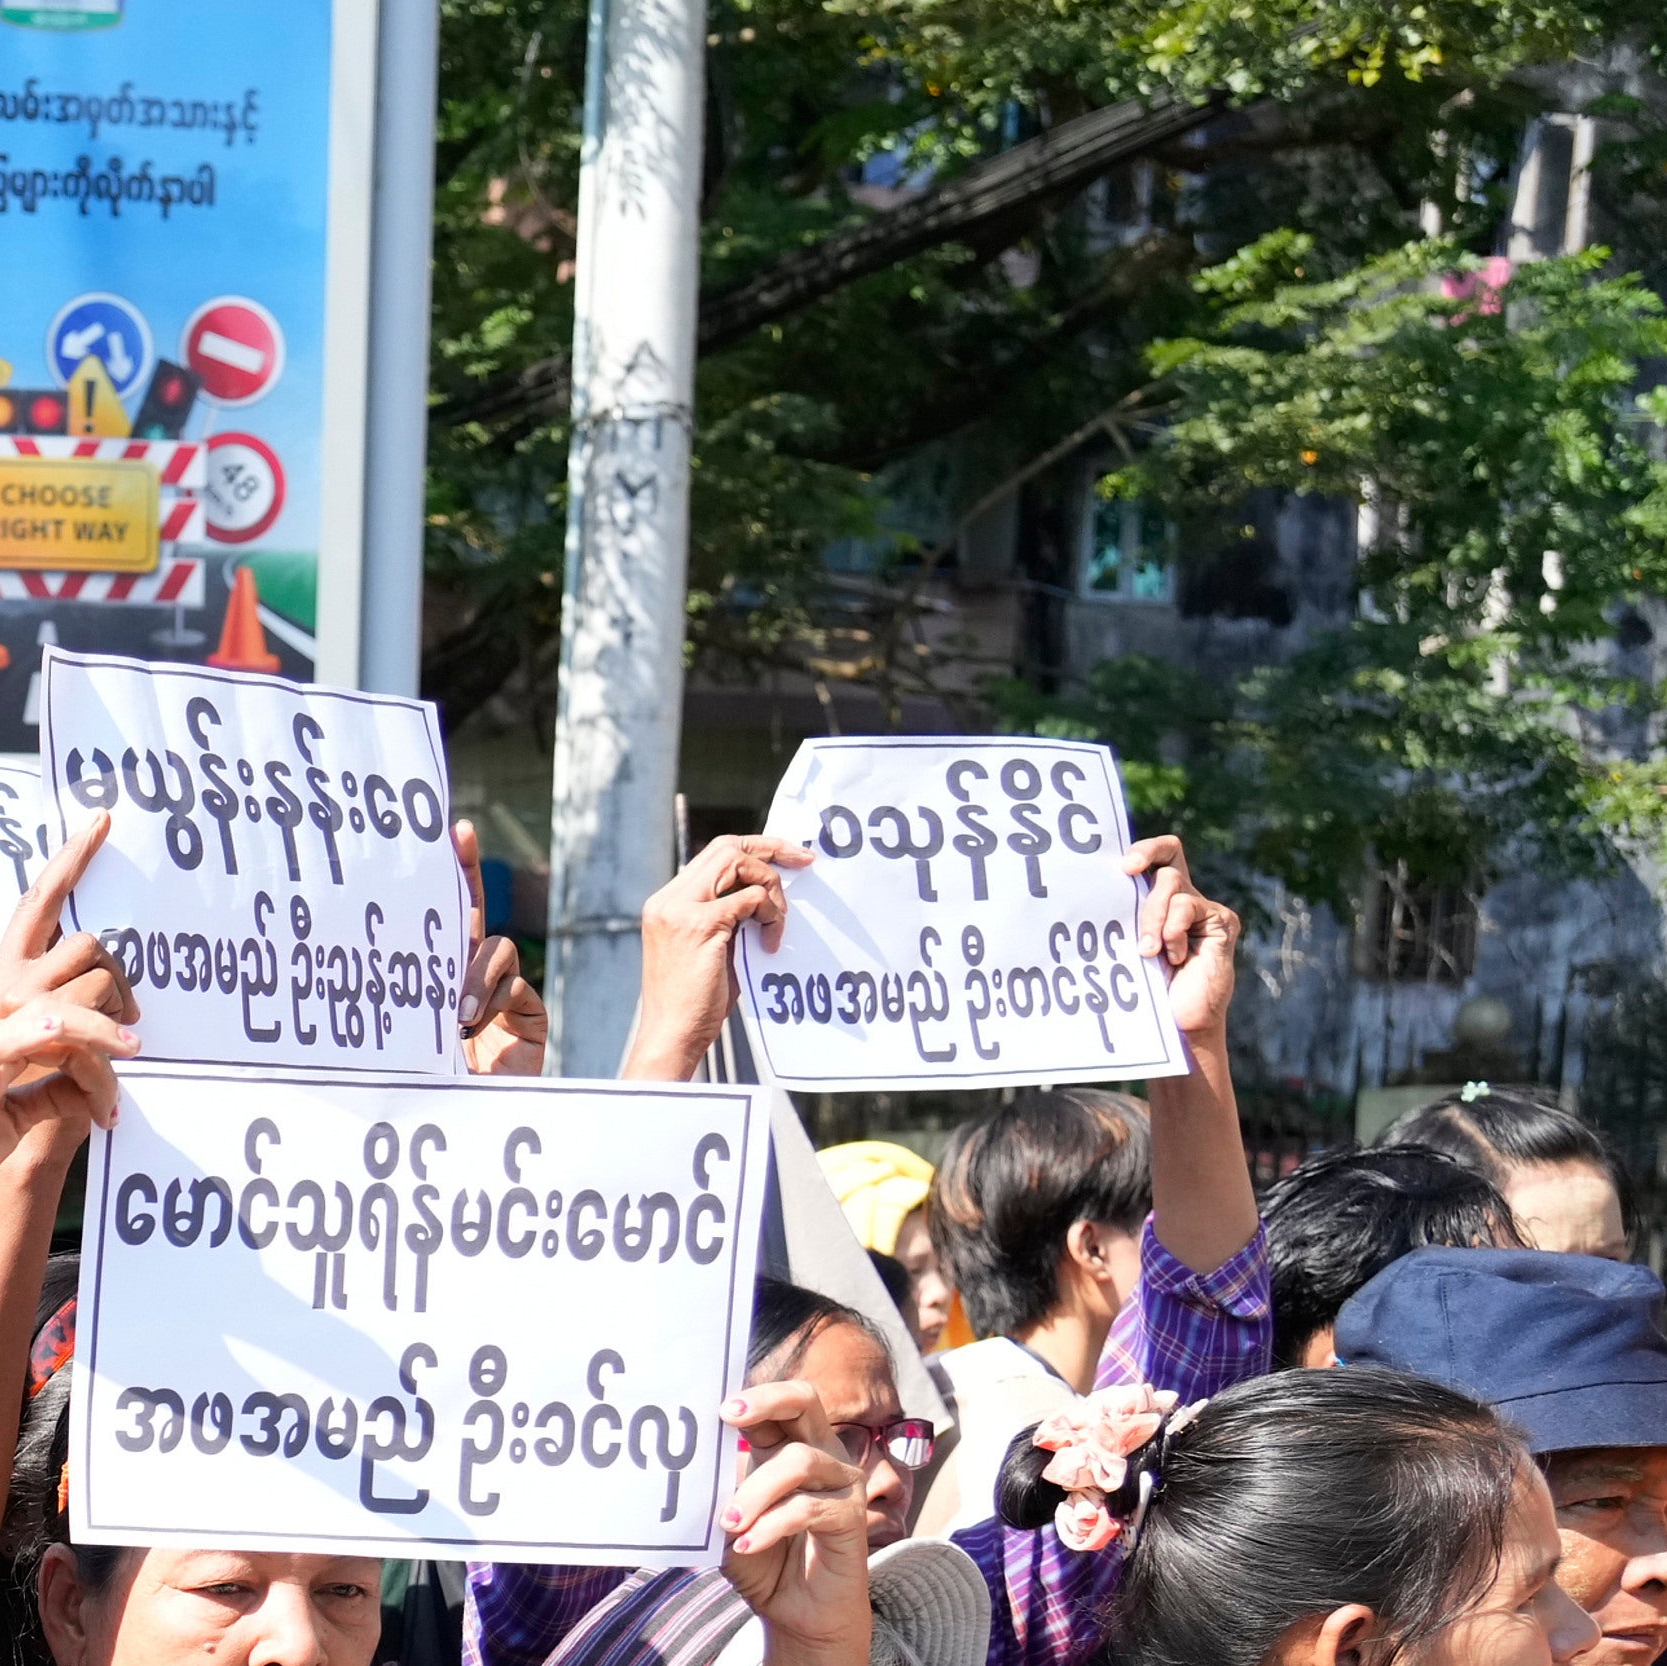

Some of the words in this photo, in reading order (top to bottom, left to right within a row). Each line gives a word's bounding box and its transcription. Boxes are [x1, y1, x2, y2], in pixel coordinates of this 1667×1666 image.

[0, 483, 113, 508] CHOOSE
[73, 520, 129, 543] WAY
[761, 925, 957, 1063] အဖအမည်
[114, 1342, 439, 1515] အဖအမည်
[458, 1344, 699, 1523] ဦးခင်လှ
